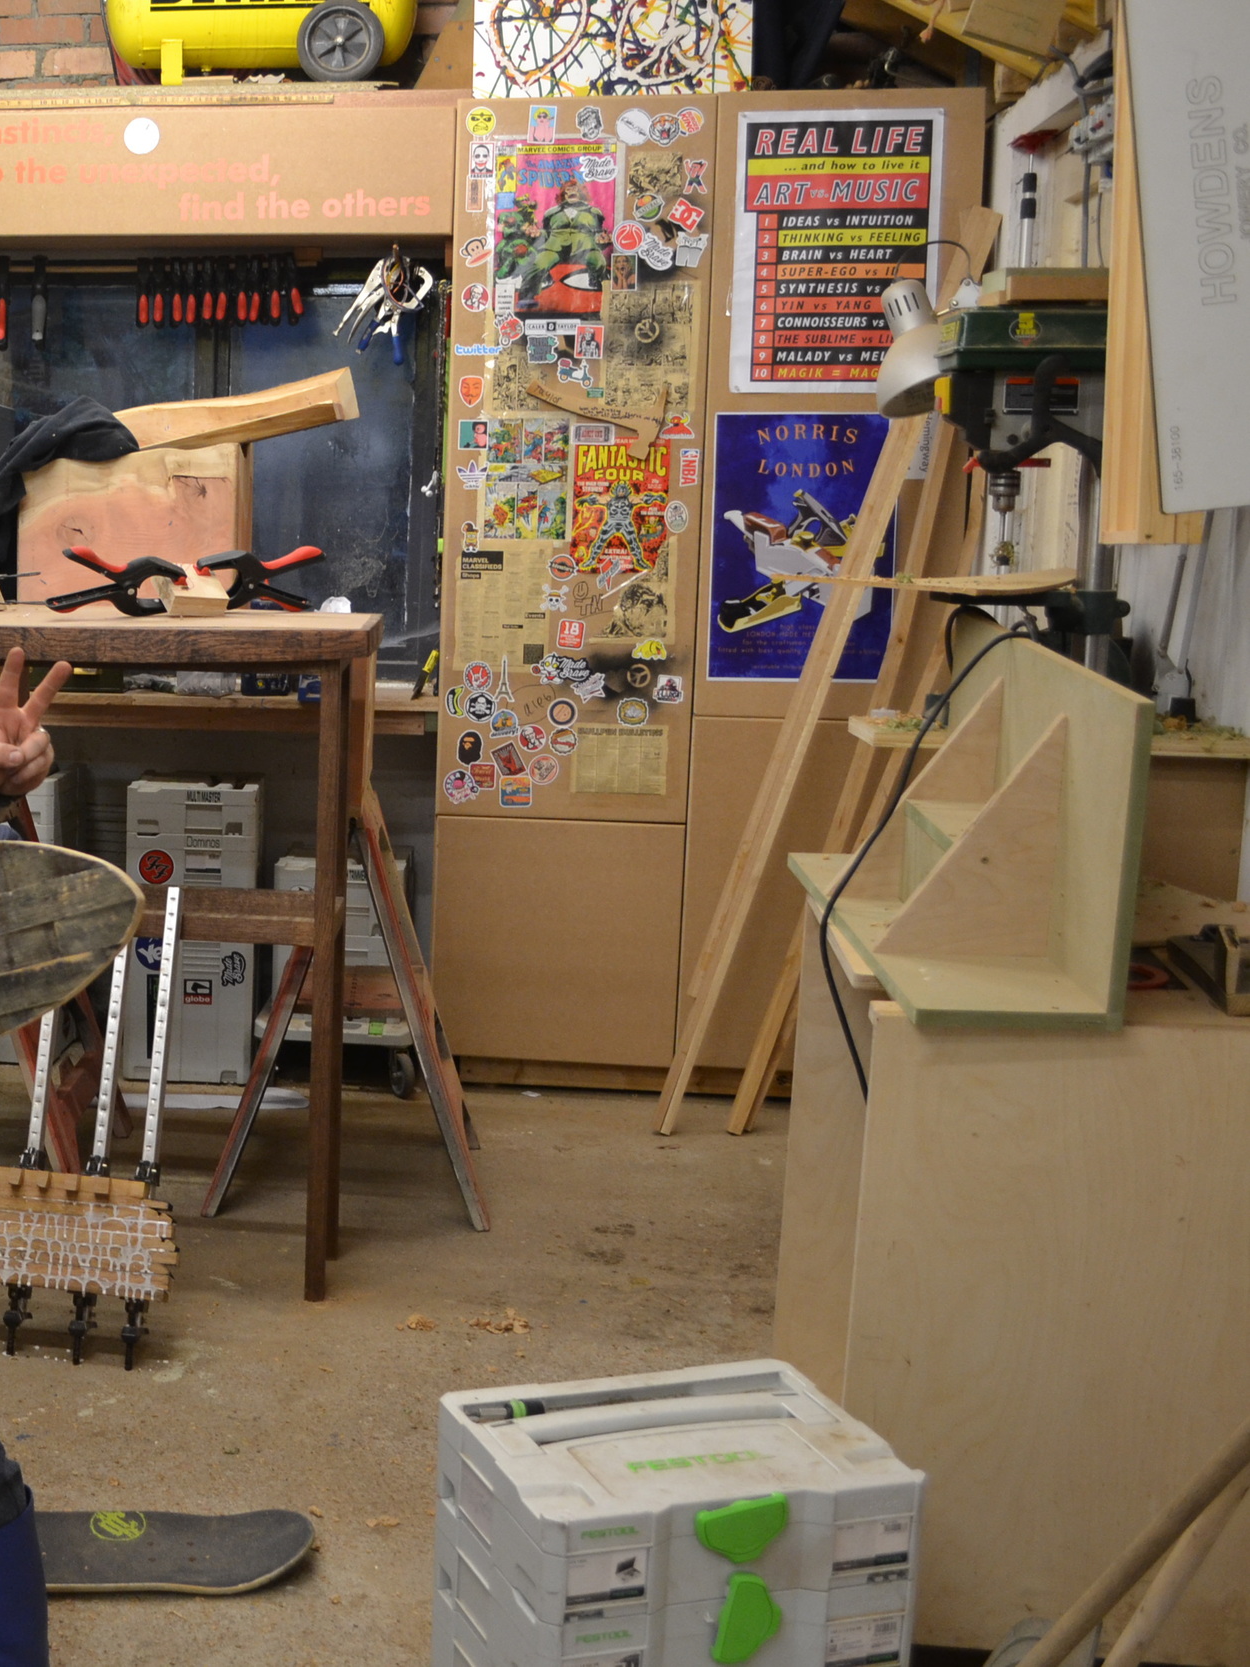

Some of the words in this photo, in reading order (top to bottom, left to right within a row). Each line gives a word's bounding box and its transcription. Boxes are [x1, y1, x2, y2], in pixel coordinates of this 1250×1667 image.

[754, 127, 838, 155] REAL
[851, 126, 925, 154] LIFE
[538, 156, 582, 169] AMAZIN
[584, 157, 612, 169] Made
[801, 161, 825, 171] and
[831, 160, 856, 170] how
[862, 161, 876, 169] to
[881, 160, 904, 169] live
[910, 160, 920, 169] it
[15, 157, 67, 184] the
[79, 153, 281, 190] unexpected,
[518, 168, 587, 188] SPIDER-M
[584, 168, 616, 180] Brave
[753, 181, 812, 206] ART
[830, 179, 920, 202] MUSIC
[1185, 75, 1237, 306] HOWDENS
[178, 191, 245, 222] find
[255, 191, 310, 219] the
[322, 188, 431, 218] others
[764, 218, 769, 226] 1
[782, 215, 820, 227] IDEAS
[826, 218, 839, 226] vs
[845, 215, 913, 226] INTUITION
[763, 235, 769, 243] 2
[782, 232, 844, 243] THINKING
[869, 232, 921, 243] FEELING
[645, 235, 670, 257] Made
[641, 249, 669, 267] Brave
[782, 250, 822, 261] BRAIN
[829, 252, 843, 260] vs
[850, 249, 892, 260] HEART
[760, 269, 767, 277] 4
[781, 266, 857, 277] SUPER-EGO
[760, 285, 767, 293] 5
[779, 283, 858, 294] SYNTHESIS
[760, 302, 767, 310] 6
[781, 300, 804, 310] YIN
[836, 300, 871, 310] YANG
[760, 319, 767, 327] 7
[777, 316, 867, 328] CONNOISSEURS
[872, 320, 884, 328] vs
[759, 335, 766, 344] 8
[777, 334, 799, 344] THE
[804, 334, 856, 344] SUBLIME
[455, 345, 501, 355] twitter
[759, 352, 766, 361] 9
[776, 351, 832, 362] MALADY
[839, 353, 852, 361] vs
[860, 351, 884, 362] MEL
[755, 369, 767, 378] 10
[777, 368, 823, 378] MAGIK
[850, 368, 878, 378] MAG
[532, 385, 563, 404] Taylor
[757, 423, 859, 445] NORRIS
[594, 468, 645, 481] FOUR
[680, 459, 699, 485] NBA
[757, 459, 854, 478] LONDON
[563, 622, 580, 635] 18
[558, 657, 587, 669] Made
[559, 668, 590, 680] Brave
[201, 791, 221, 803] MASTER
[186, 836, 220, 849] Dominos
[138, 946, 162, 964] Ye
[222, 957, 234, 987] Made
[185, 994, 210, 1002] globe
[626, 1450, 773, 1473] FESTOOL
[580, 1525, 640, 1540] FESTOOL
[575, 1629, 633, 1644] FESTOOL
